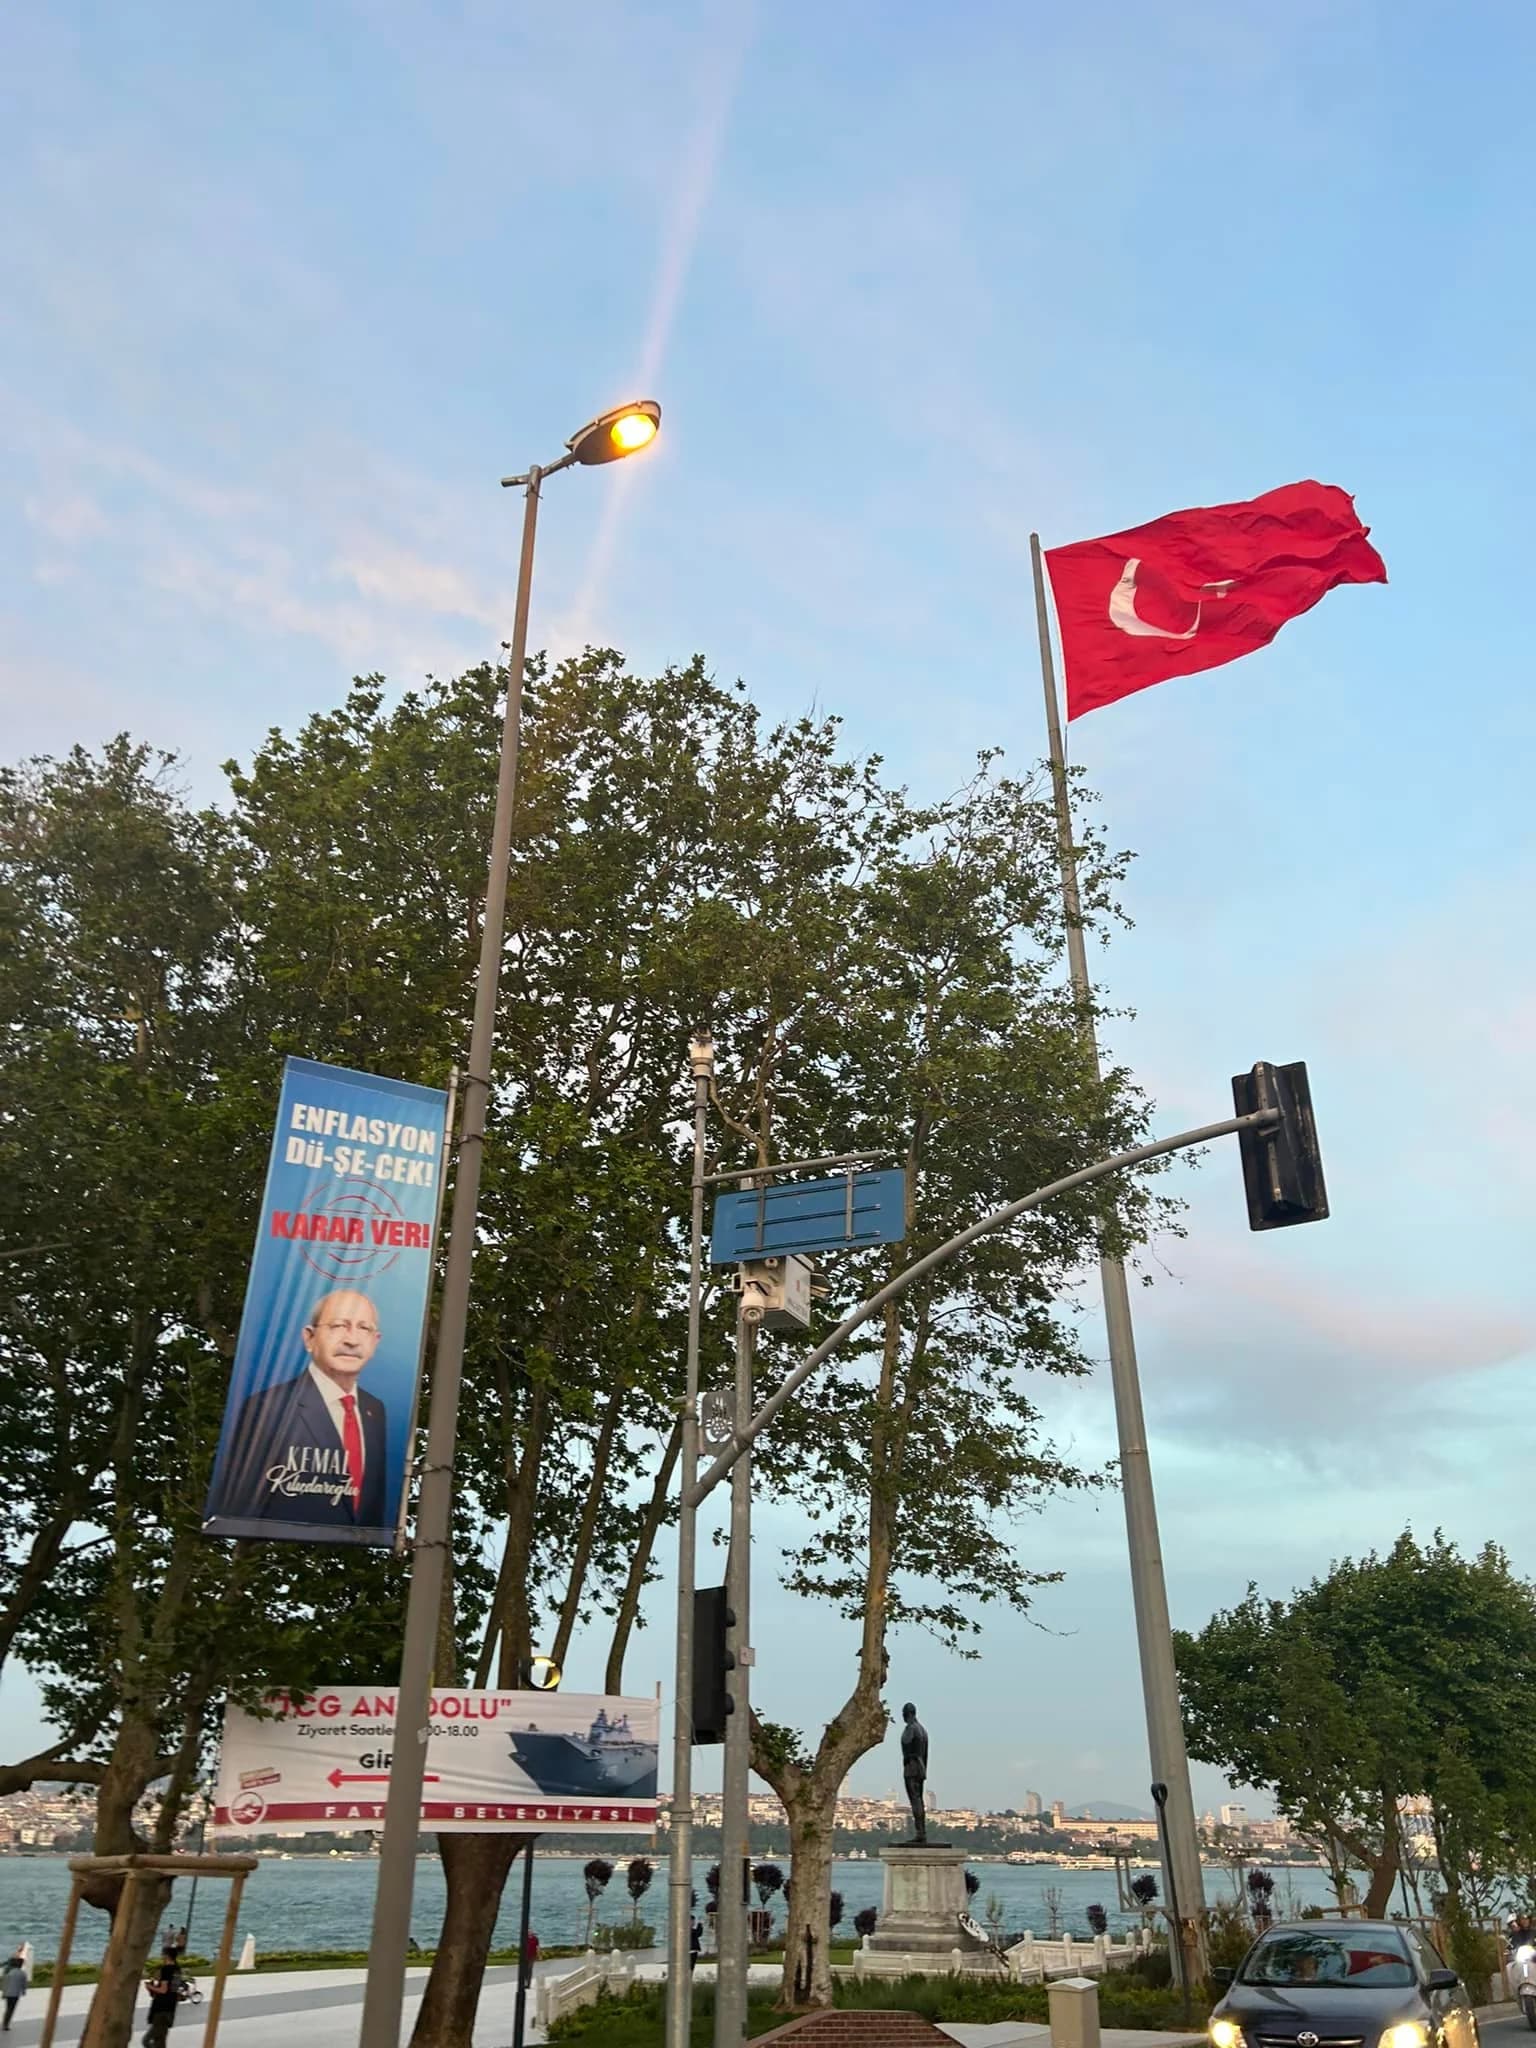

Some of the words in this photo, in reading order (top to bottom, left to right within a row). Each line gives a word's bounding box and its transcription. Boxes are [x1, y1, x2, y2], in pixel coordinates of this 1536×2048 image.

[290, 1102, 436, 1156] ENFLASYON
[270, 1210, 365, 1244] KARAR
[370, 1219, 431, 1248] VER!
[286, 1445, 352, 1476] KEMAL
[298, 1724, 346, 1738] Ziyaret
[351, 1724, 394, 1736] Saatle
[454, 1806, 634, 1820] BELEDİYESİ
